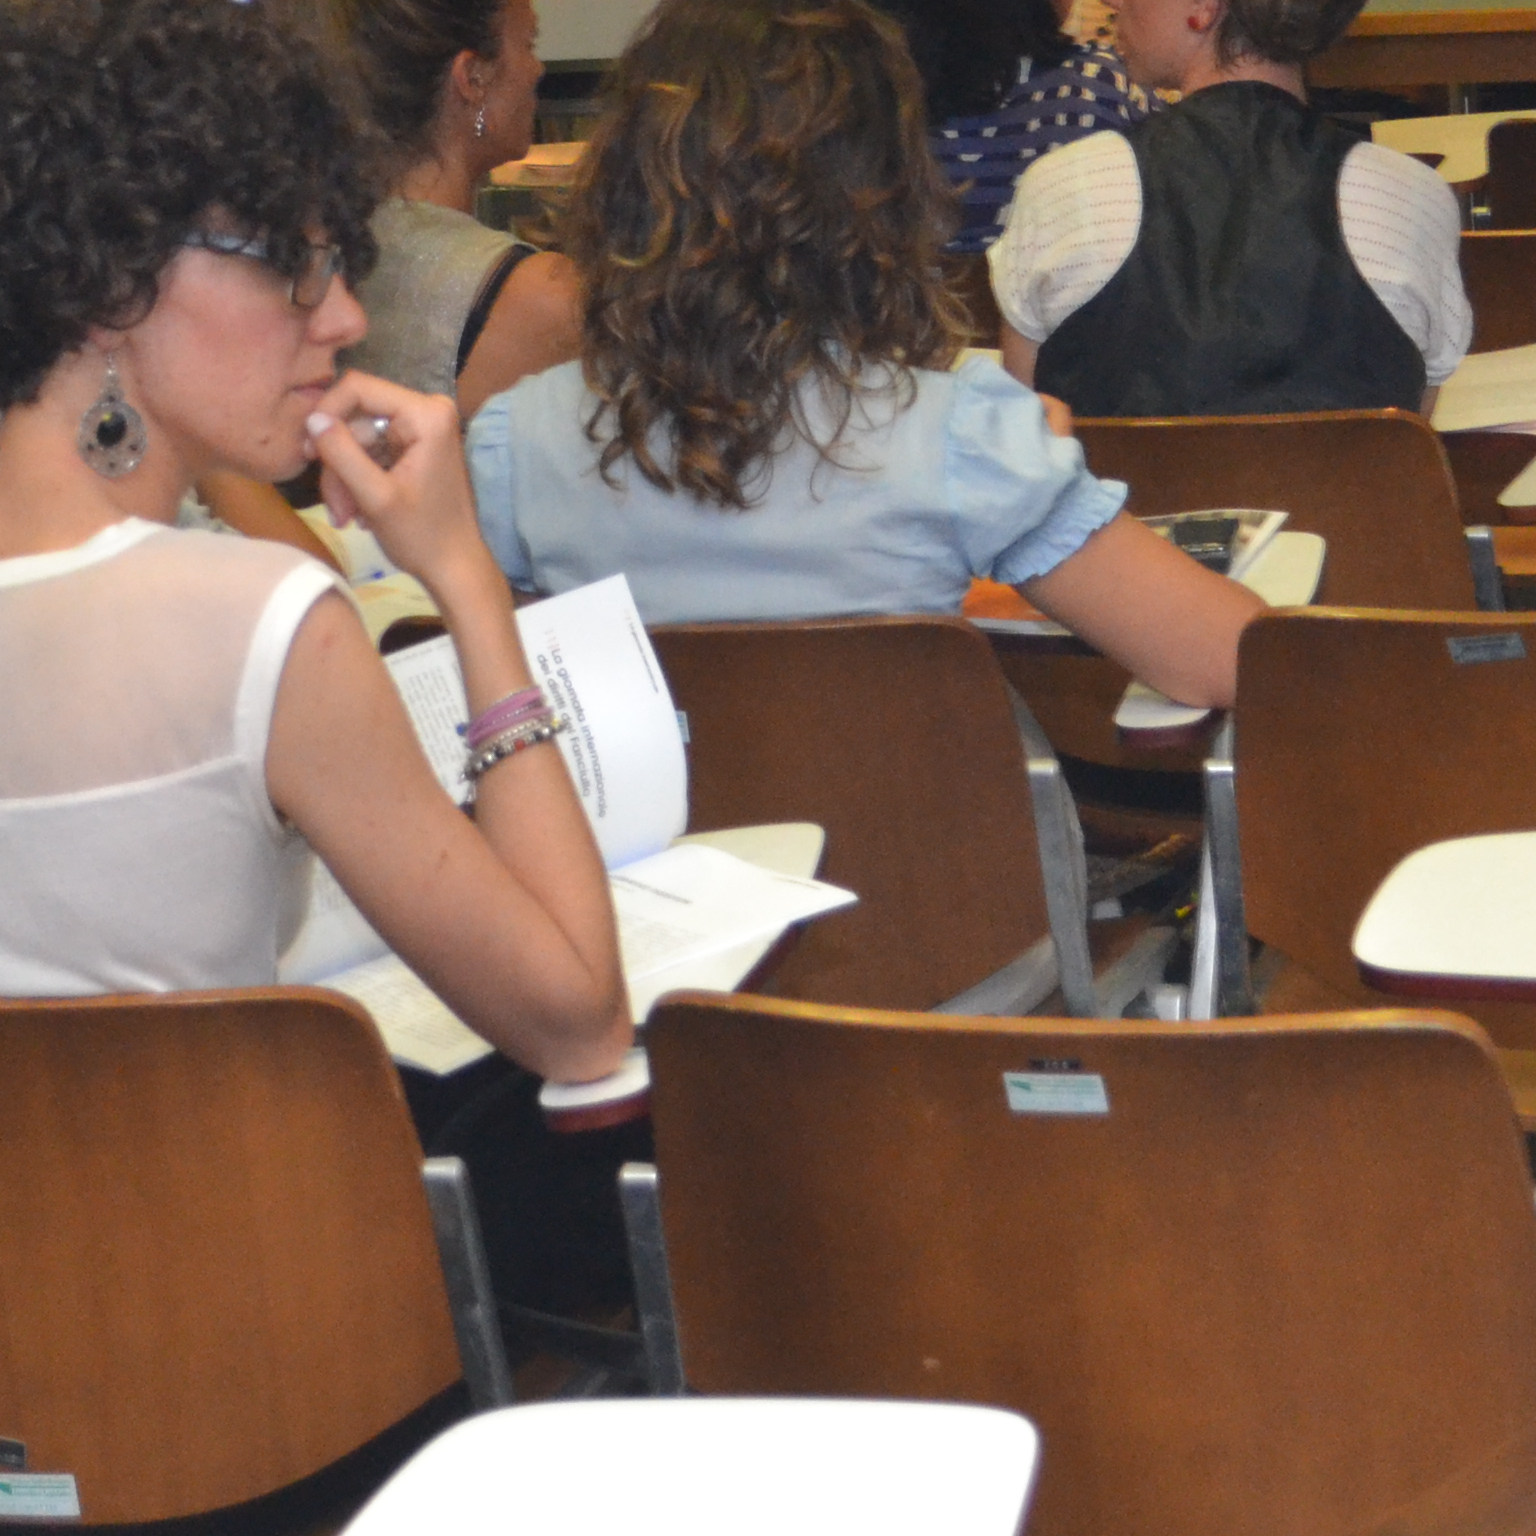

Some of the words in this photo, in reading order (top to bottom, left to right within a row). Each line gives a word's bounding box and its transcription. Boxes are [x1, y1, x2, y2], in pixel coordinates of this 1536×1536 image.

[537, 654, 550, 675] dei
[570, 737, 591, 797] Fanciullo
[551, 648, 563, 665] La
[557, 668, 586, 723] giornata
[581, 725, 607, 818] internazionale
